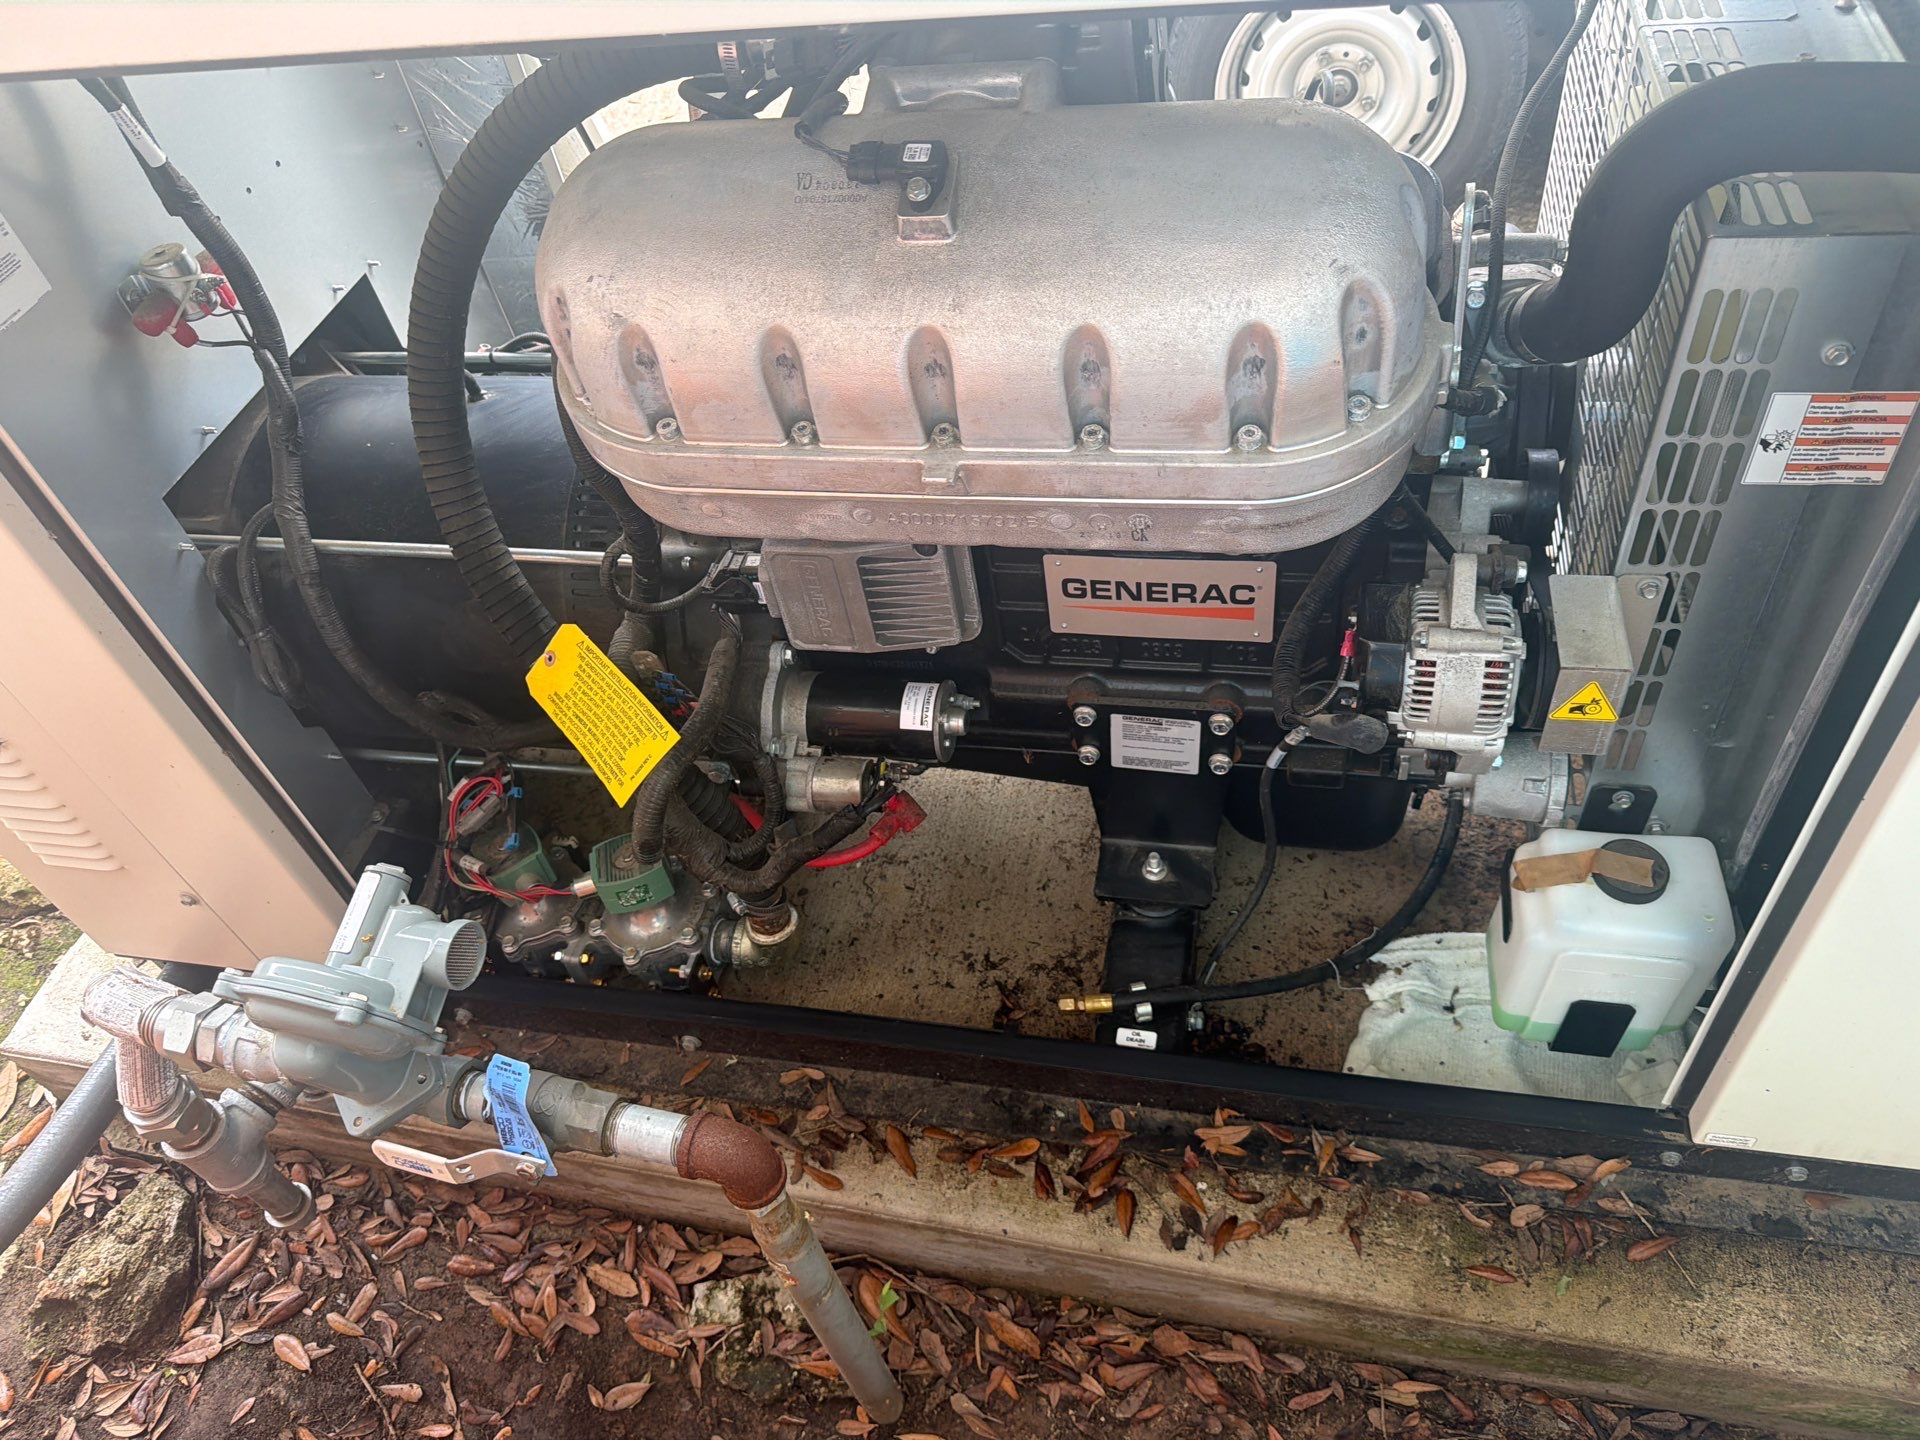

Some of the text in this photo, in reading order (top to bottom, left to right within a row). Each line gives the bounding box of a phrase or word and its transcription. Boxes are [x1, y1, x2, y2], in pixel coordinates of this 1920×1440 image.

[1061, 577, 1256, 605] GENERAC
[576, 652, 586, 662] THIS
[584, 660, 606, 682] GENERATOR
[603, 681, 614, 690] HAS
[611, 688, 623, 699] BEEN
[631, 709, 640, 718] THE
[637, 716, 653, 734] FACTORY
[650, 732, 657, 740] TO
[584, 644, 664, 730] IMPORTANT INSTALLATION INFORMATION
[604, 702, 626, 725] GENERATOR
[923, 685, 934, 726] GENERAC
[1122, 715, 1163, 723] GENERAC
[630, 720, 647, 739] CORRECT
[496, 1116, 510, 1145] NIBCO
[394, 1159, 432, 1174] NIBCO
